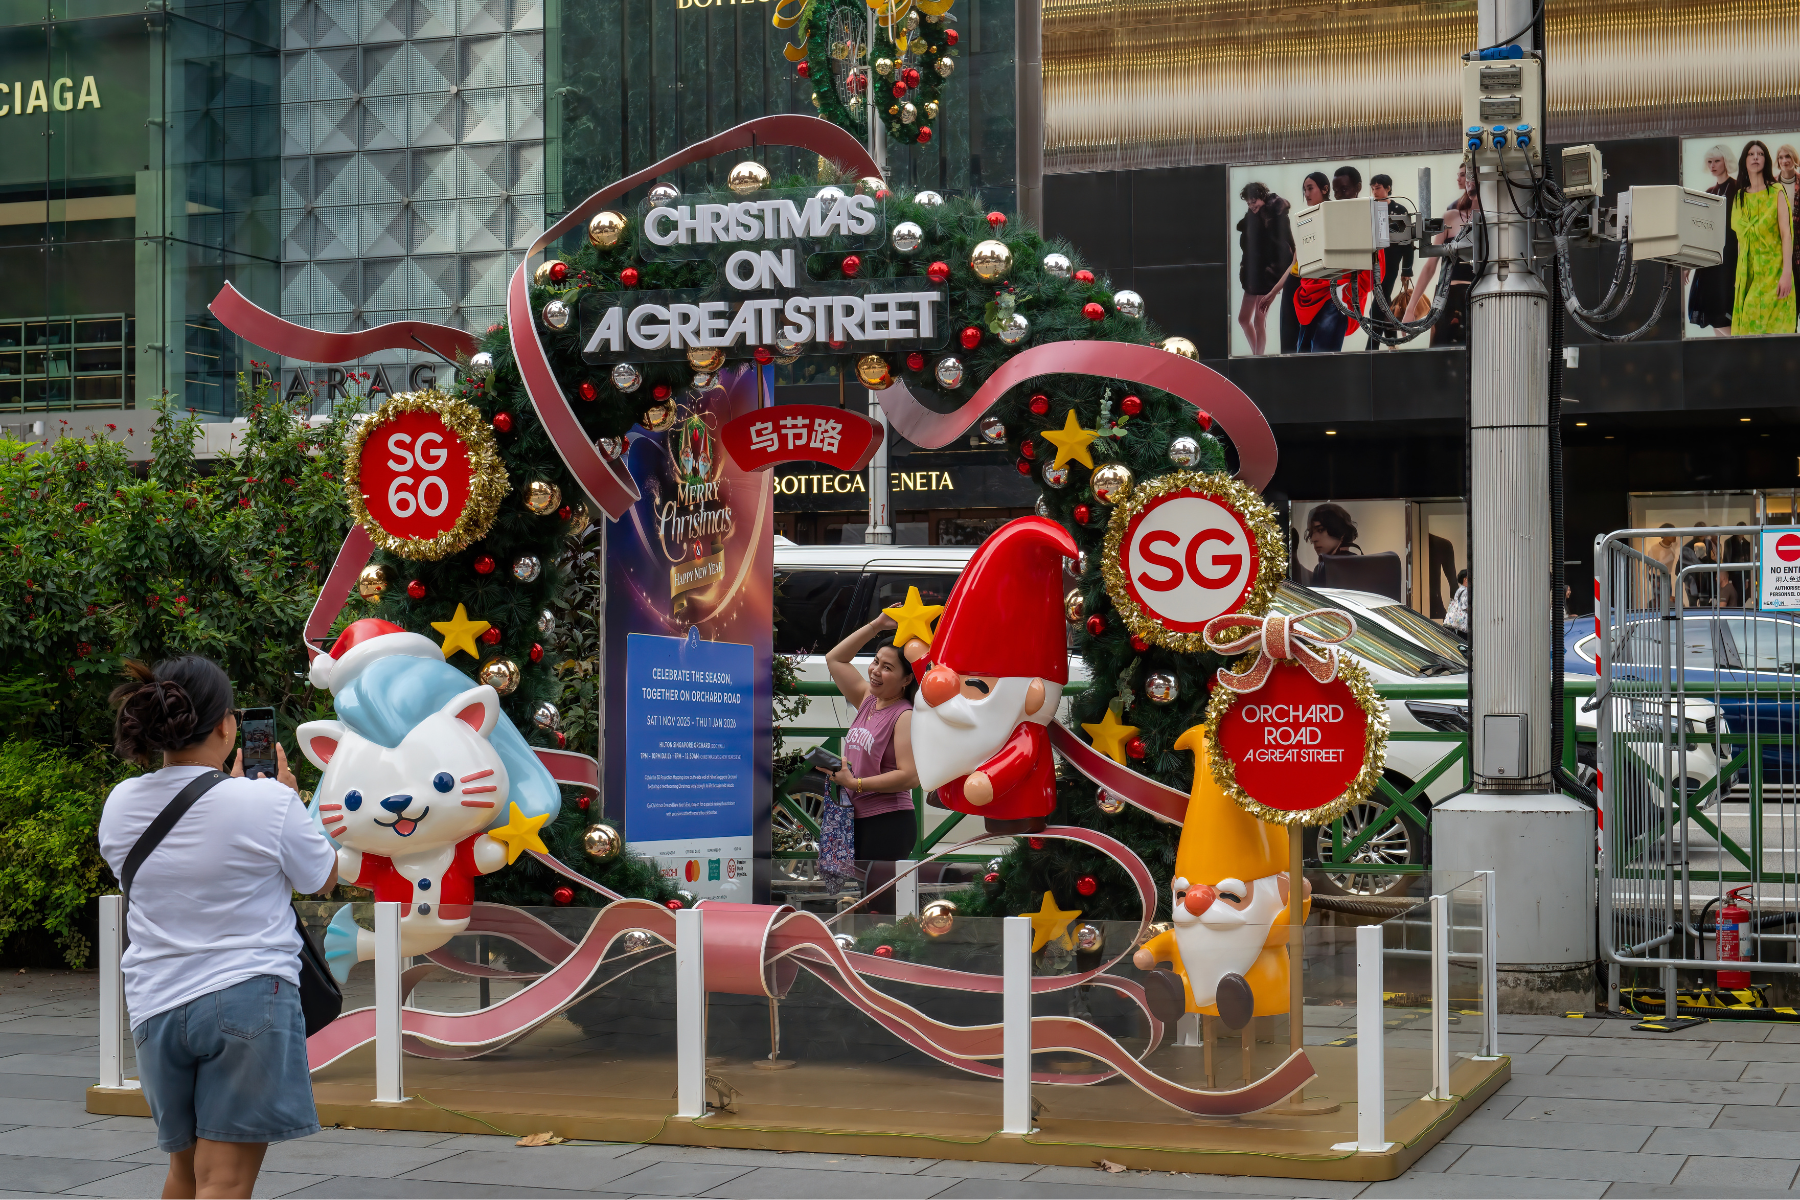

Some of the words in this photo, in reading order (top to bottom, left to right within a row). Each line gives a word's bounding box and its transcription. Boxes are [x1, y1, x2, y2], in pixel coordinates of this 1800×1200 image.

[644, 194, 876, 247] CHRISTMAS
[725, 248, 795, 291] ON
[583, 306, 624, 353] A
[627, 299, 784, 350] GREAT
[784, 291, 941, 343] STREET
[750, 415, 842, 454] 乌节路
[387, 432, 448, 472] SG
[677, 481, 720, 508] MERRY
[774, 473, 866, 494] BOTTEGA
[891, 471, 954, 492] ENETA
[388, 475, 449, 518] 60
[654, 500, 732, 563] Christmas
[1137, 528, 1243, 592] SG
[674, 570, 694, 587] HAPPY
[694, 566, 708, 581] NEW
[708, 561, 723, 575] YEAR
[652, 667, 690, 682] CELEBRATE
[691, 670, 704, 683] THE
[705, 671, 733, 687] SEASON,
[642, 688, 679, 701] TOGETHER
[680, 690, 690, 702] ON
[691, 690, 723, 703] ORCHARD
[723, 692, 741, 704] ROAD
[646, 715, 658, 726] SAT
[662, 716, 676, 726] NOV
[676, 716, 691, 727] 2025
[695, 717, 708, 728] THU
[712, 718, 723, 728] JAN
[723, 718, 737, 729] 2026
[1241, 704, 1344, 723] ORCHARD
[1264, 727, 1322, 745] ROAD
[1243, 749, 1254, 762] A
[1255, 748, 1299, 762] GREAT
[1300, 748, 1345, 762] STREET
